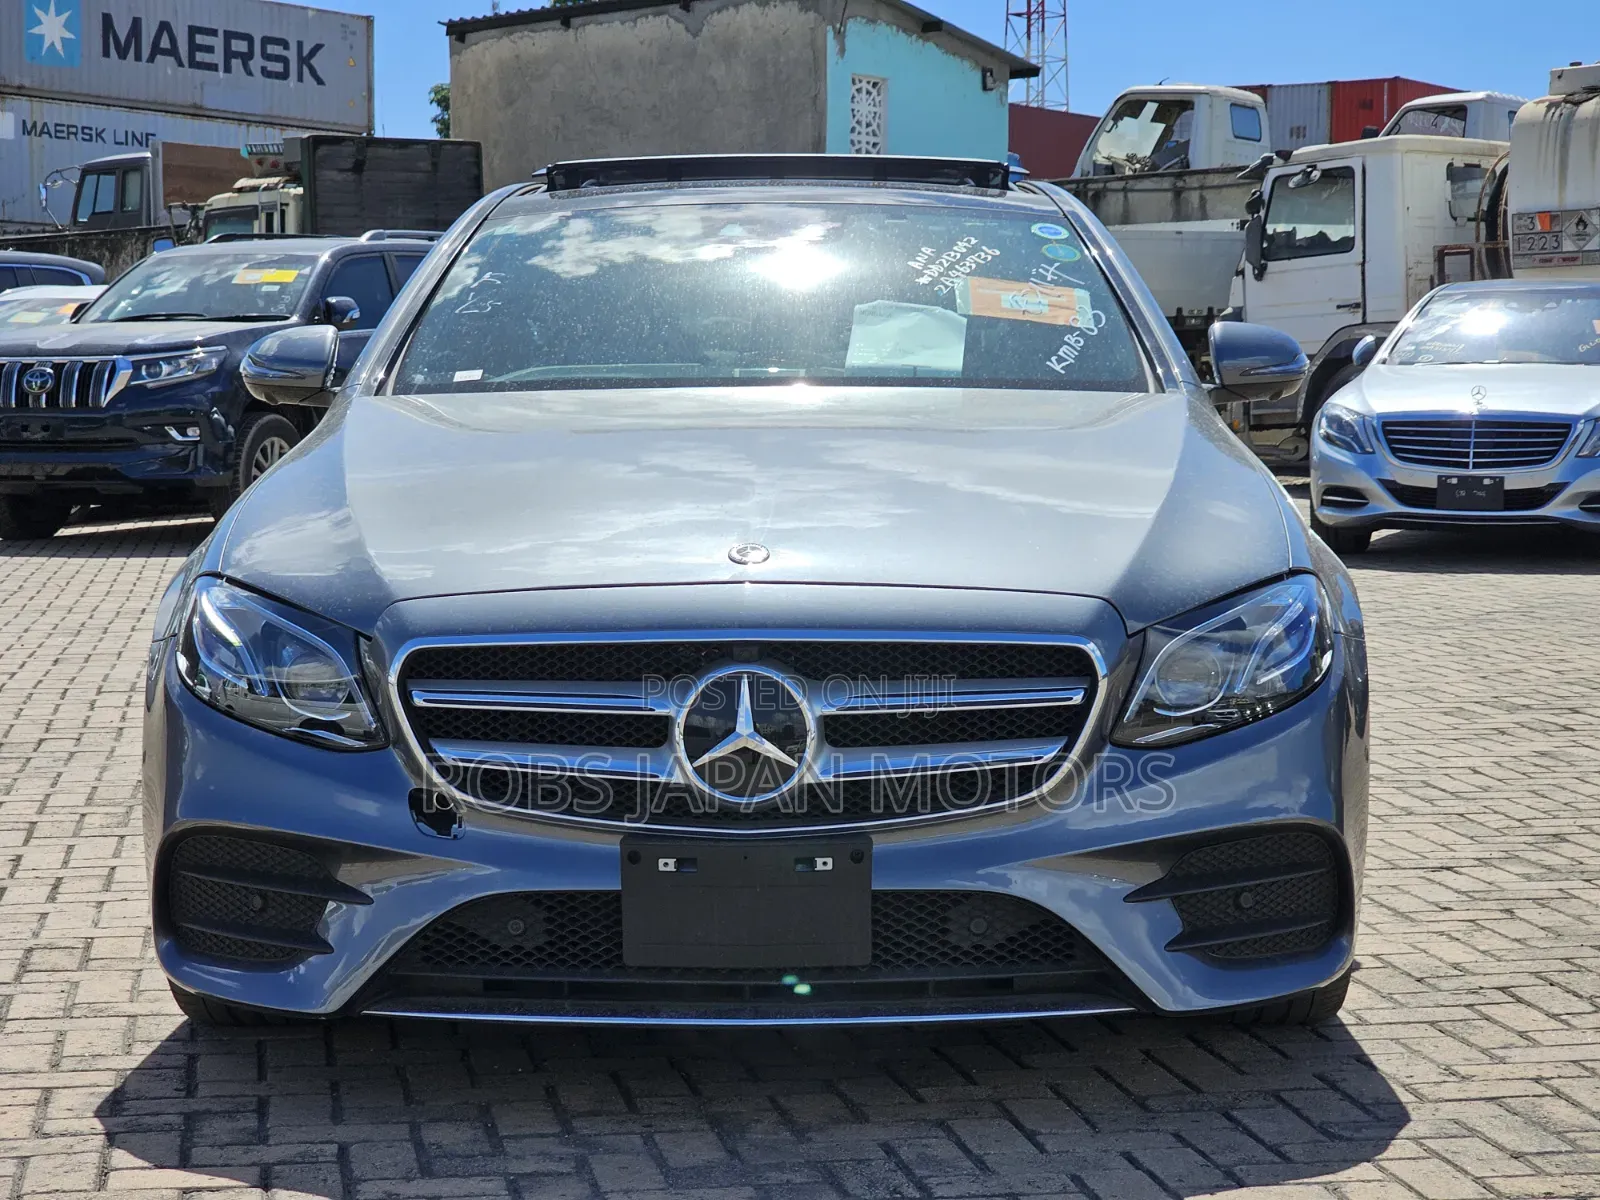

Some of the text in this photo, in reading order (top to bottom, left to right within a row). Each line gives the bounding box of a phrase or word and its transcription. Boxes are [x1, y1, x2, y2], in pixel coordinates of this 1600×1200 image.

[101, 12, 326, 86] MAERSK
[22, 119, 107, 144] MAERSK
[1517, 234, 1561, 251] 1223
[907, 246, 936, 270] ANA
